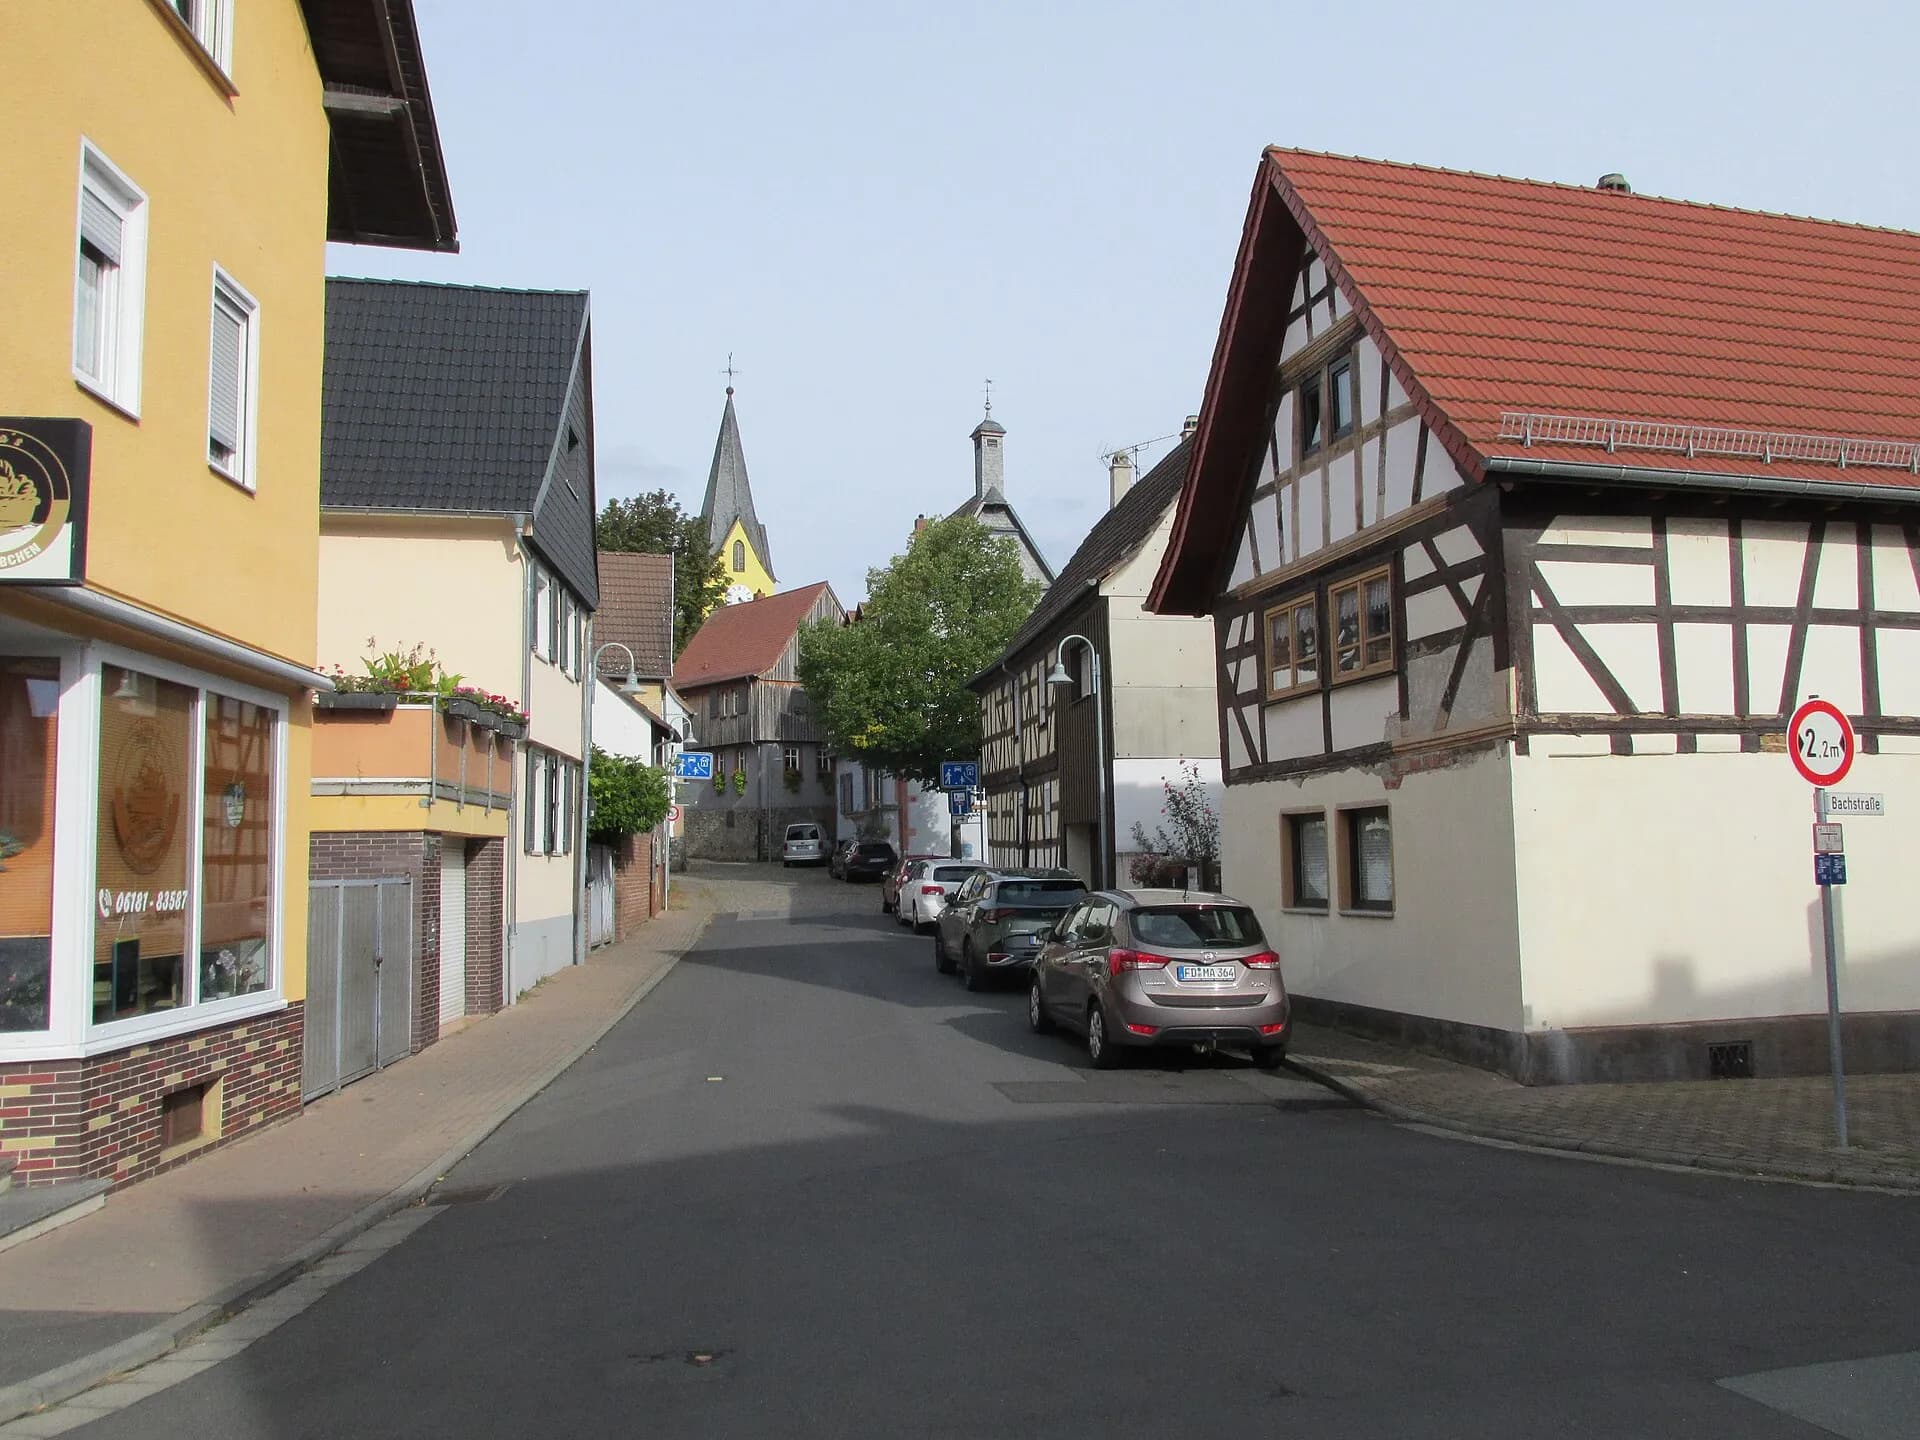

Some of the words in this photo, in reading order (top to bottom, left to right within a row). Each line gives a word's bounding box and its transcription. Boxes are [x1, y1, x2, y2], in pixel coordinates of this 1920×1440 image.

[1831, 796, 1880, 810] Bachstraße
[116, 891, 149, 913] 06181
[156, 890, 189, 912] 83587
[1184, 967, 1197, 978] FD
[1217, 967, 1234, 978] 364
